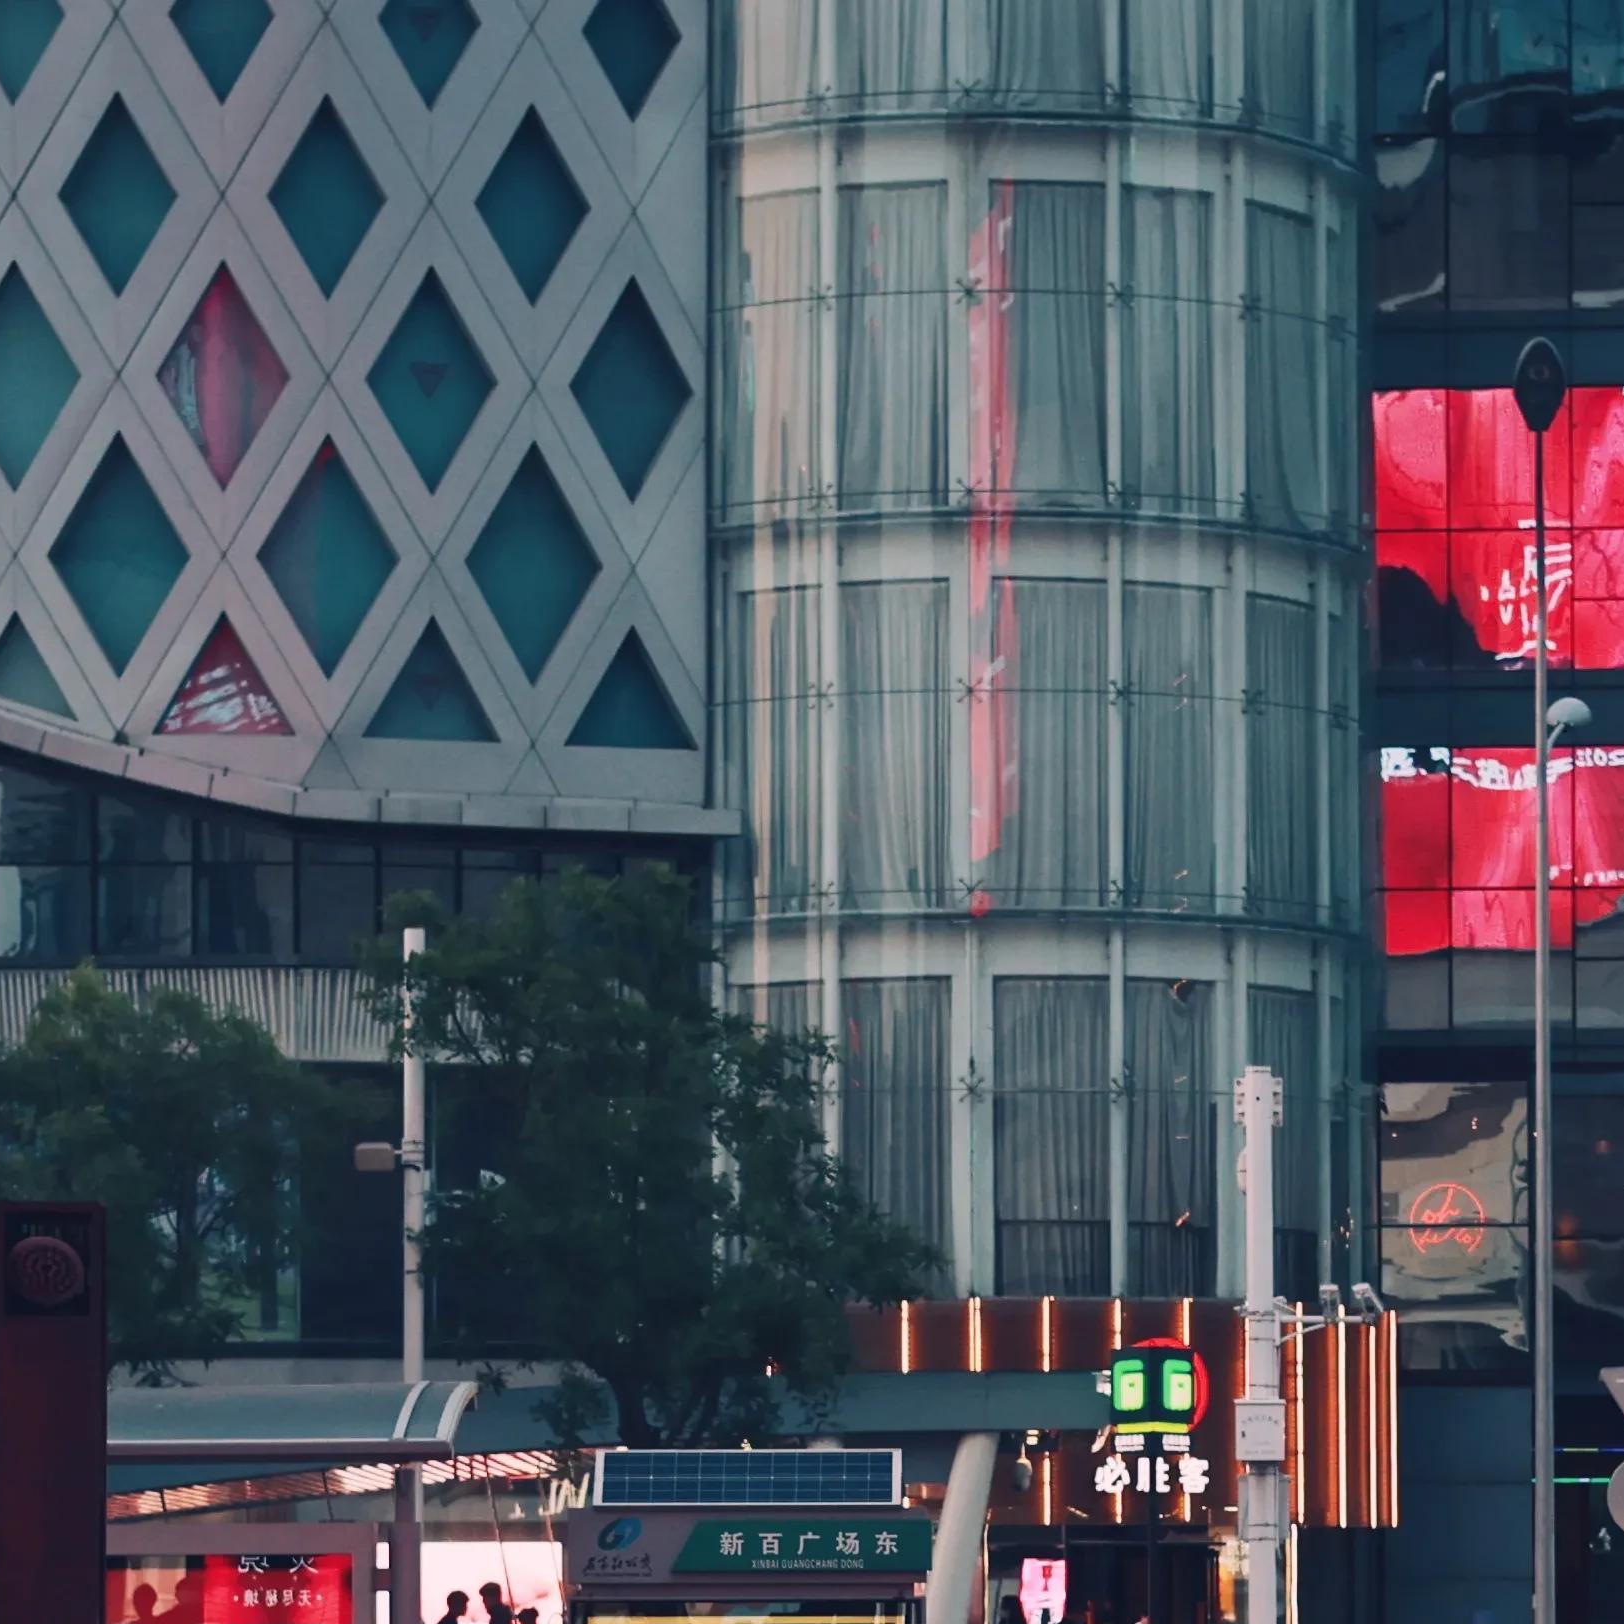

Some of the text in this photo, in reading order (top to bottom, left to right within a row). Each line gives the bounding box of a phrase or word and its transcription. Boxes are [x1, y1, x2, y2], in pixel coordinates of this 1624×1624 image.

[720, 1532, 899, 1556] 新百广场东
[751, 1558, 865, 1570] XINBAI GUANGCHANG DONG
